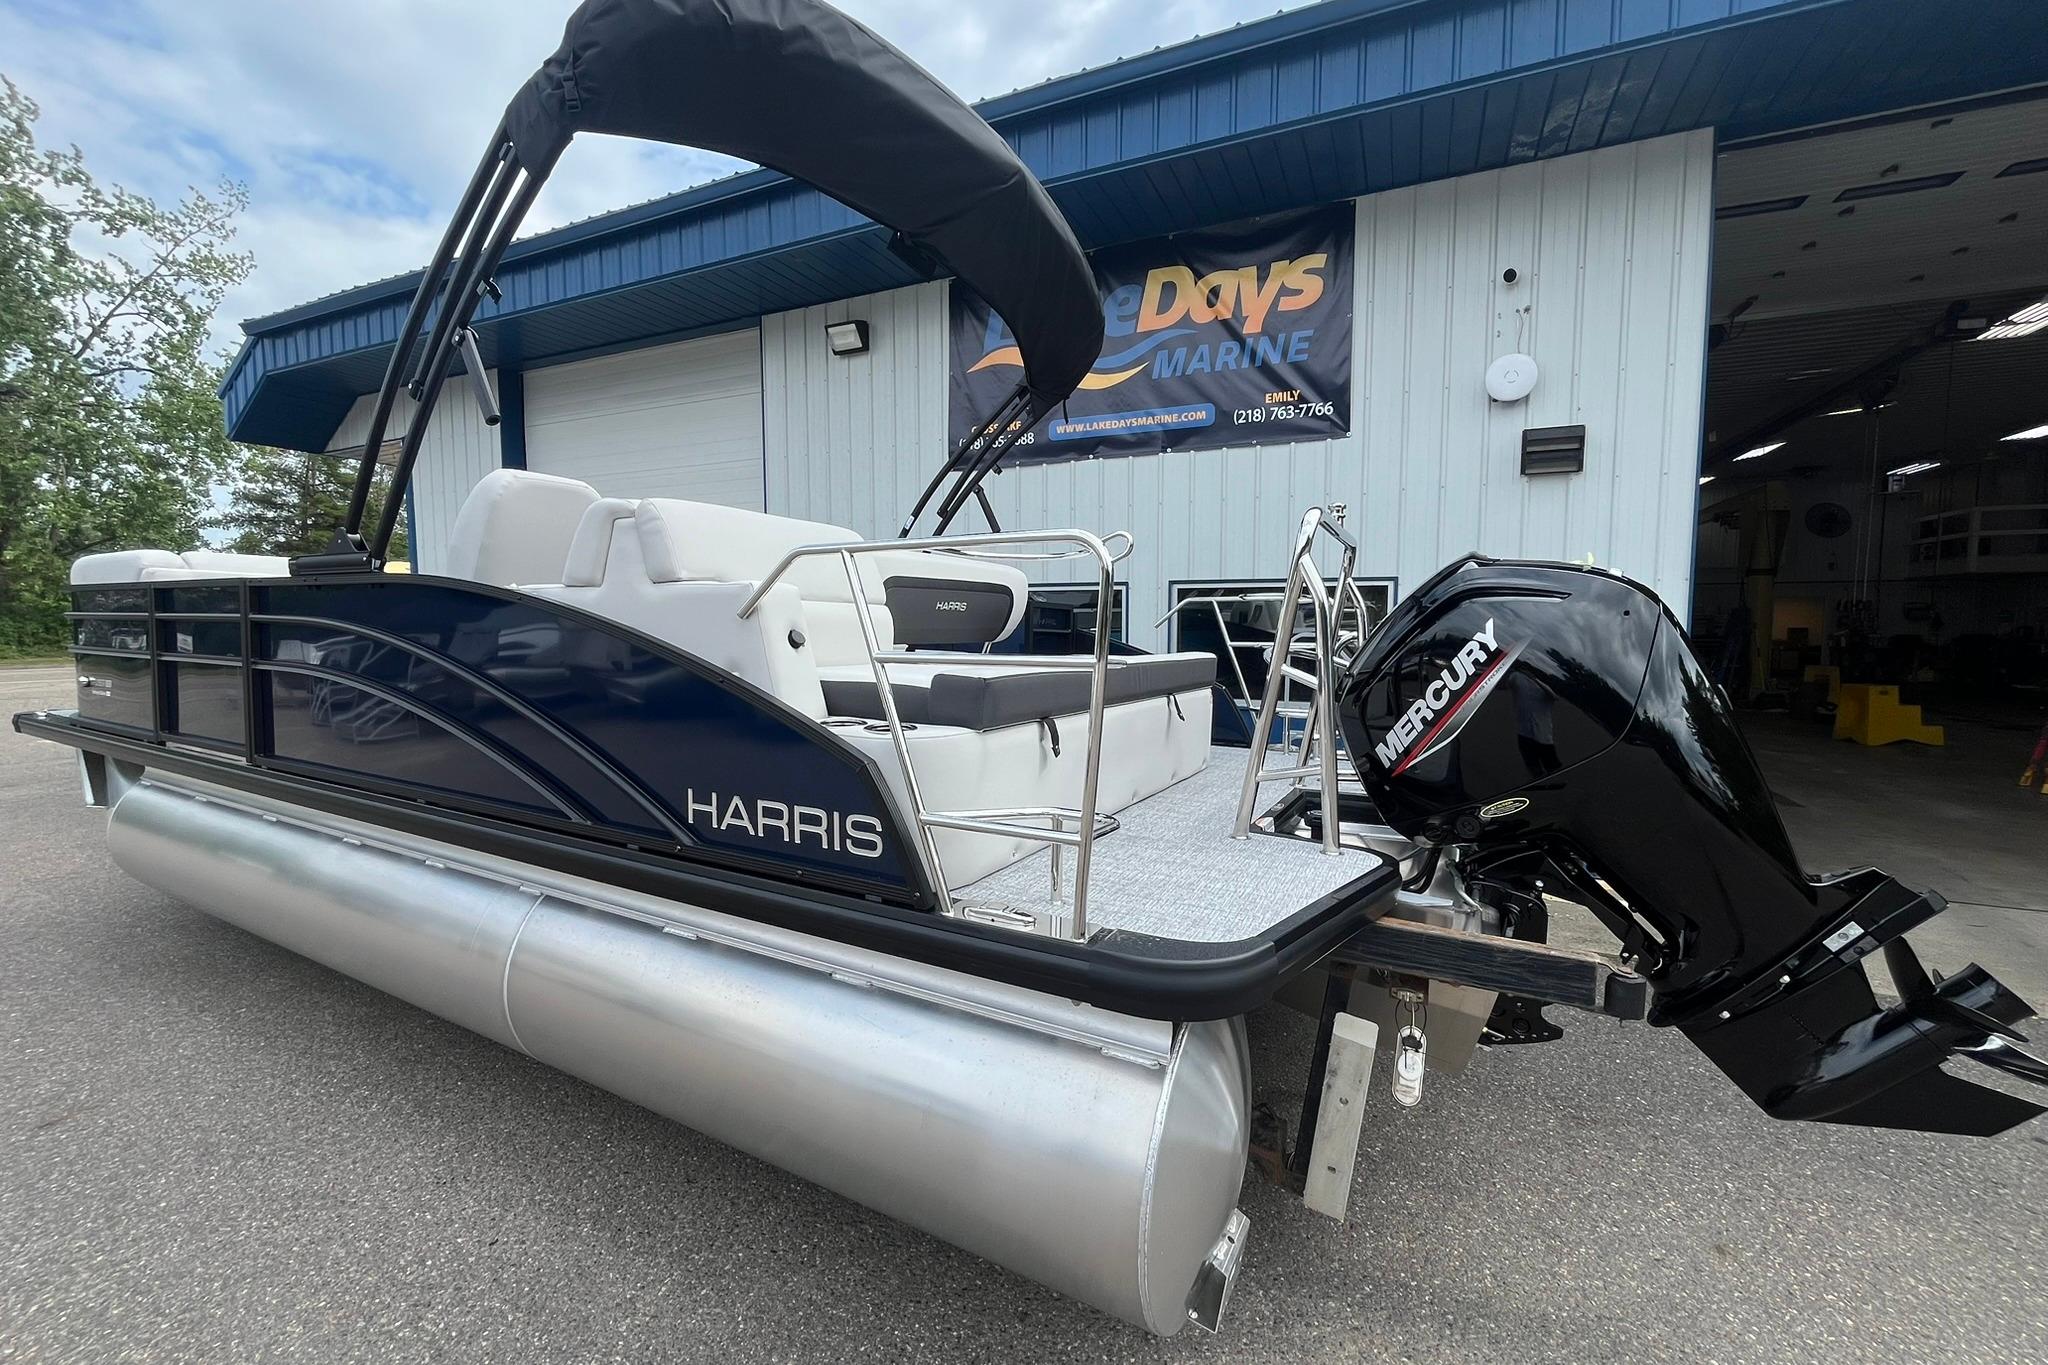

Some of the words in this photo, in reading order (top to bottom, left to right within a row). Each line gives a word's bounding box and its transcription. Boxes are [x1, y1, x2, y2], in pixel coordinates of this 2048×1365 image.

[1136, 253, 1328, 334] Days
[1152, 330, 1314, 380] MARINE
[1233, 407, 1266, 425] (218)
[1270, 401, 1334, 420] 763-7766
[1265, 389, 1301, 403] EMILY
[1056, 410, 1206, 434] WWW.LAKEDAYSMARINE.COM
[935, 601, 968, 612] HARRIS
[1375, 617, 1499, 769] MERCURY
[687, 788, 883, 858] HARRIS
